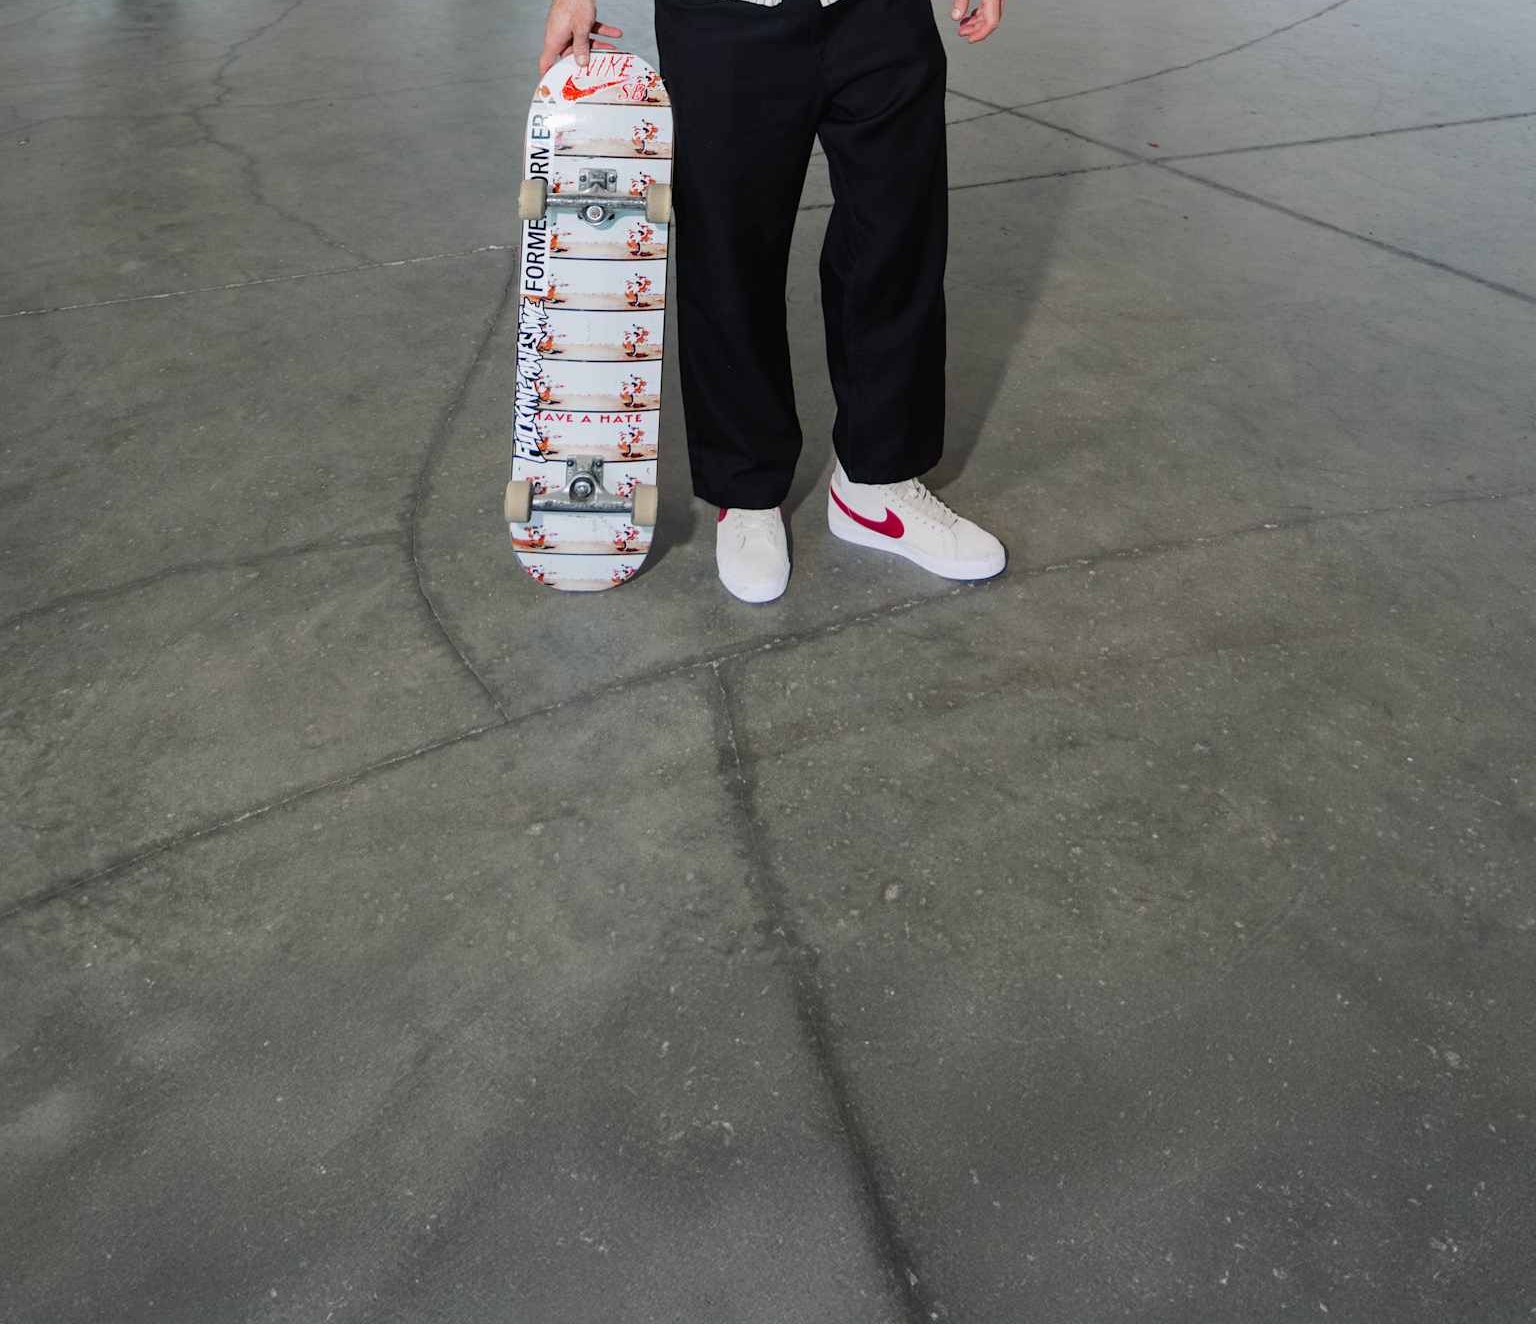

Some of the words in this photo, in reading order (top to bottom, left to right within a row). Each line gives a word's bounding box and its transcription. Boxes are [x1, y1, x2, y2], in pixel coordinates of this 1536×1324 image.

[577, 56, 634, 78] NIKE
[618, 83, 645, 100] SB
[525, 214, 547, 292] FORME
[581, 414, 592, 423] A
[600, 414, 642, 423] HATE
